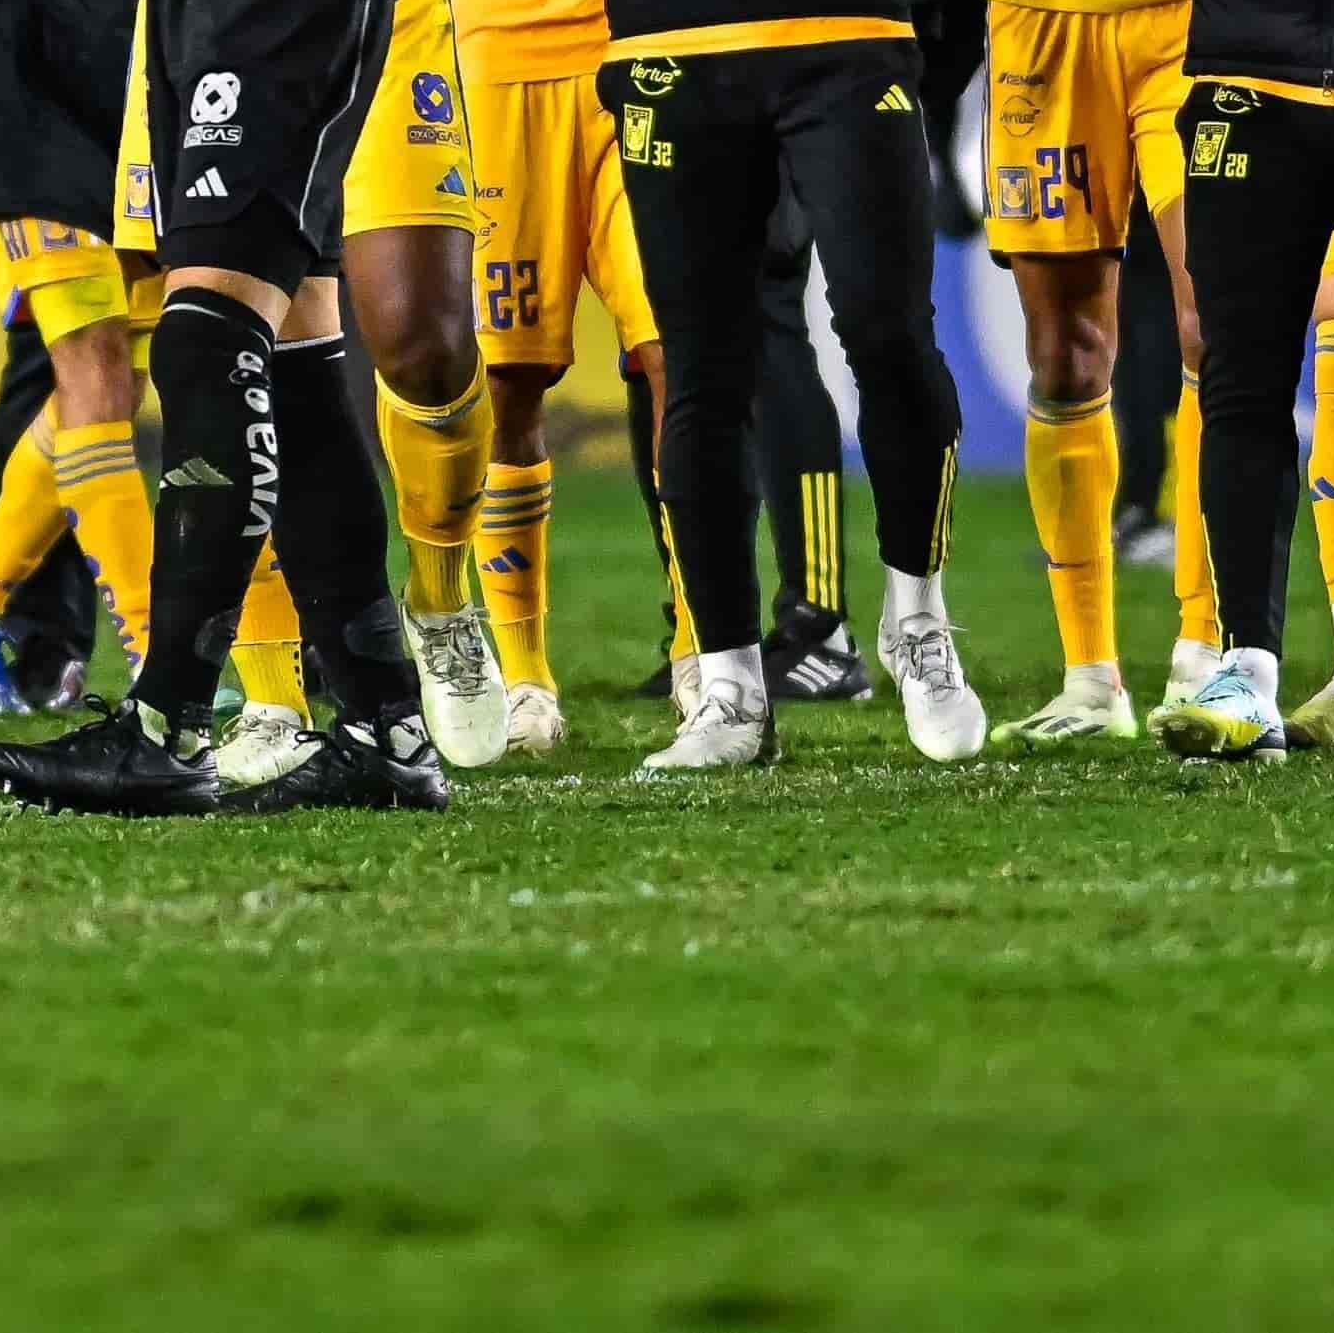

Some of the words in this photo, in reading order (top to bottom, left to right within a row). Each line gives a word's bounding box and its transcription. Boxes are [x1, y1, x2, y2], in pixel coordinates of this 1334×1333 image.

[630, 61, 675, 84] Vertua
[203, 128, 241, 143] GAS
[652, 140, 672, 167] 32
[1225, 154, 1248, 177] 28
[1036, 144, 1092, 218] 29
[474, 187, 504, 199] MEX
[486, 261, 540, 329] 22
